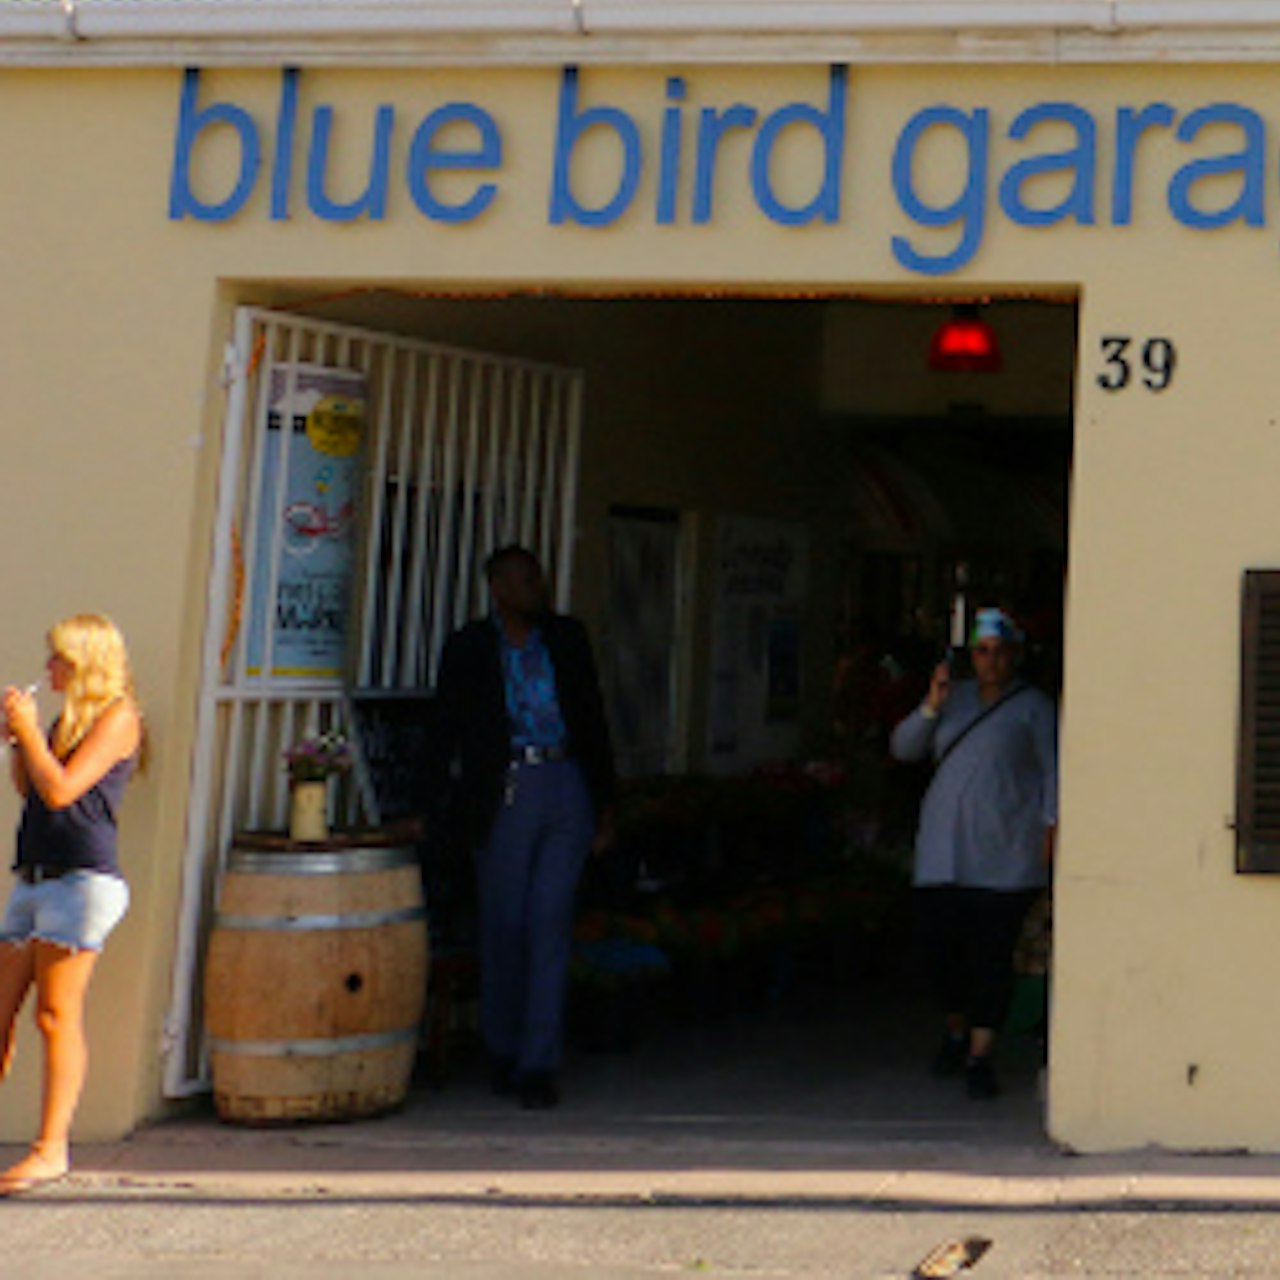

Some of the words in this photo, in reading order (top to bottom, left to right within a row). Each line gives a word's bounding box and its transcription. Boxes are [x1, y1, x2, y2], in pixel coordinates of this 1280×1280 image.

[169, 65, 504, 222] blue
[548, 65, 850, 226] bird
[1096, 336, 1178, 391] 39
